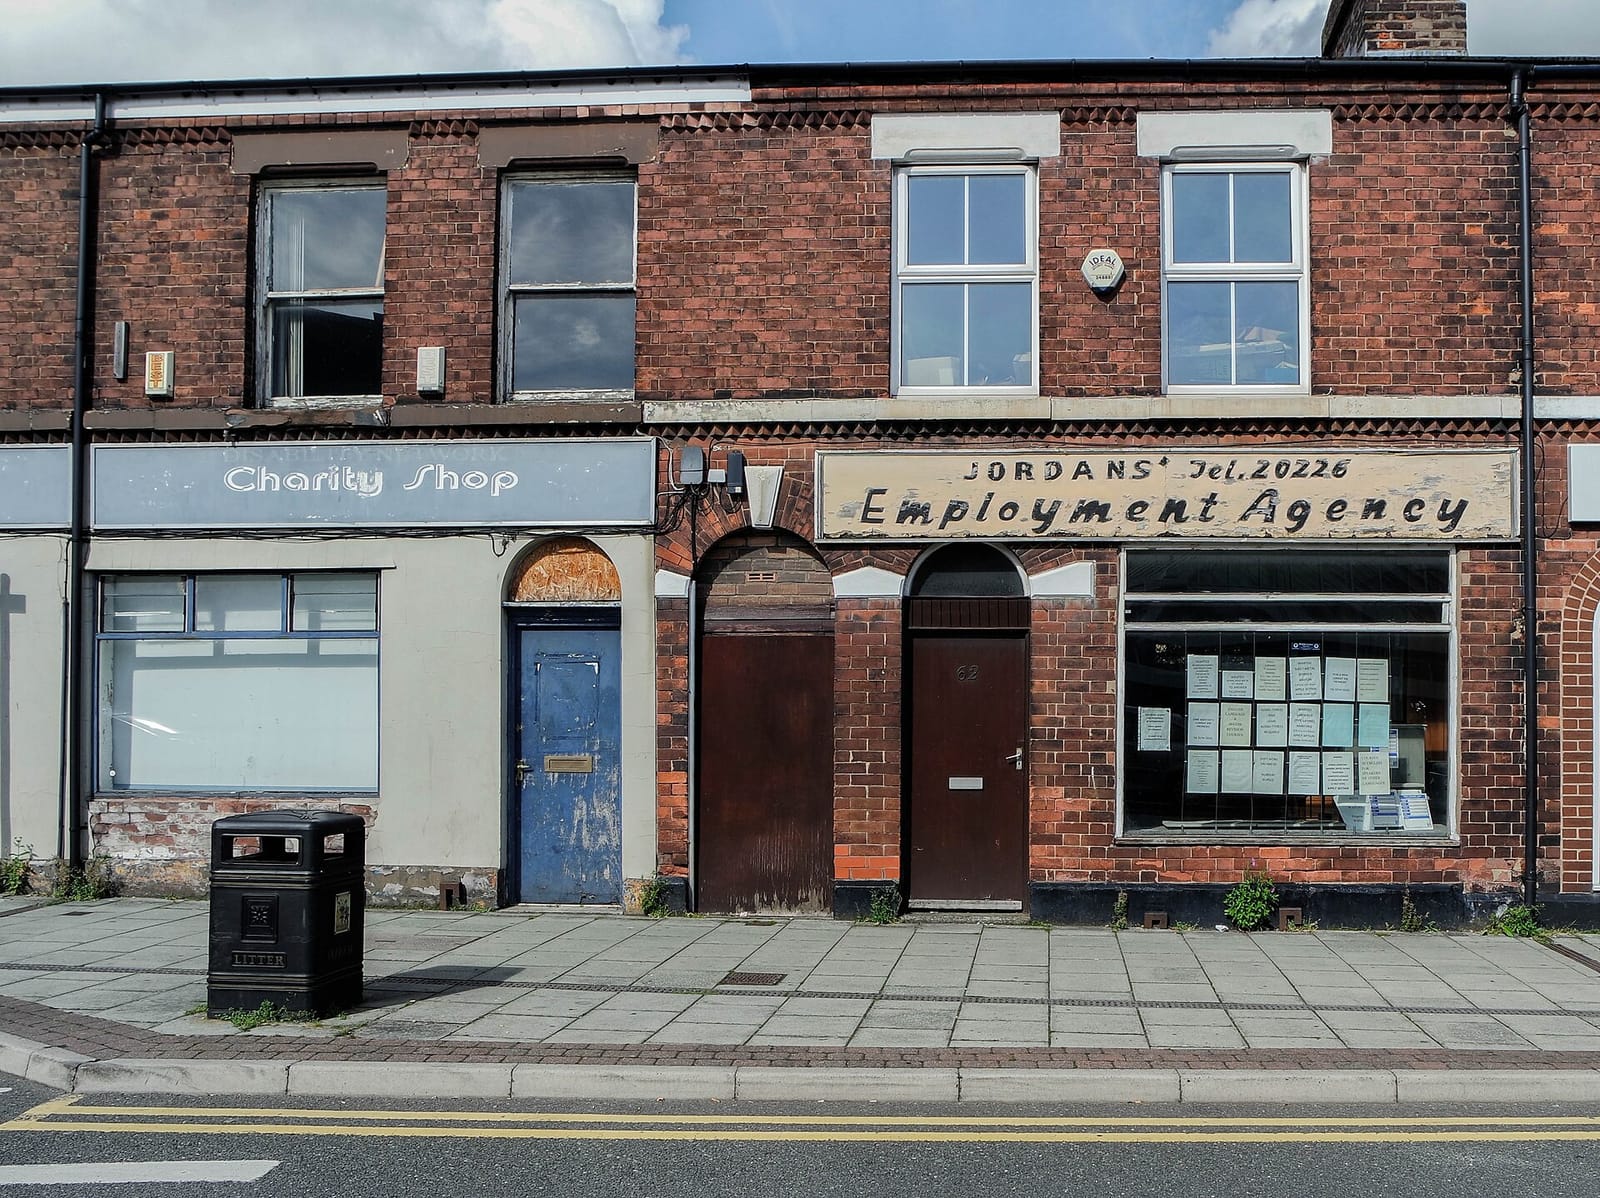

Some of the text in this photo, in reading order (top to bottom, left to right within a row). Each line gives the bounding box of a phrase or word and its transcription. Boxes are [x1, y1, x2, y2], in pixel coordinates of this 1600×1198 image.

[1089, 255, 1116, 266] IDEAL
[223, 463, 520, 498] Charity Shop
[860, 488, 1470, 534] Employment Agency
[956, 664, 979, 681] 62
[234, 953, 285, 965] LITTER
